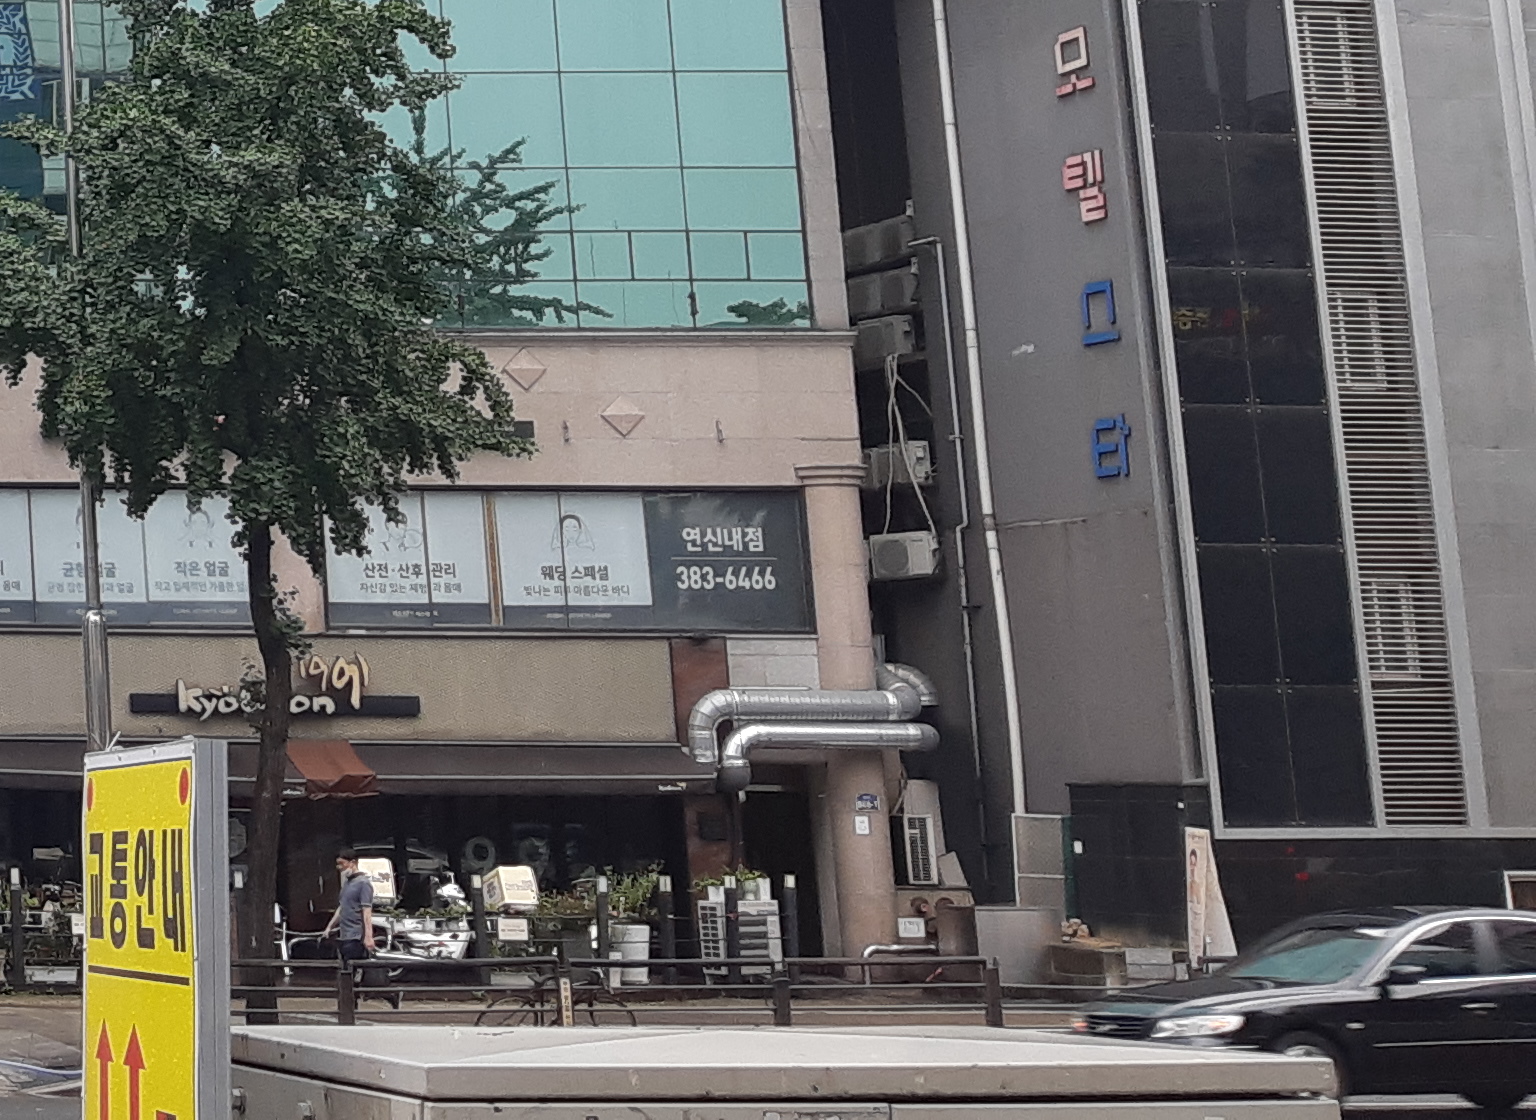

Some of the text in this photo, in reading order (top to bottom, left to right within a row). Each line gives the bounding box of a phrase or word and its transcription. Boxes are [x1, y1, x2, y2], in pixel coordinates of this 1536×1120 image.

[681, 526, 765, 553] 연신내점
[174, 560, 231, 578] 작은 얼굴
[431, 562, 458, 579] 관리
[675, 565, 777, 591] 383-6466
[89, 827, 188, 954] 교통안내
